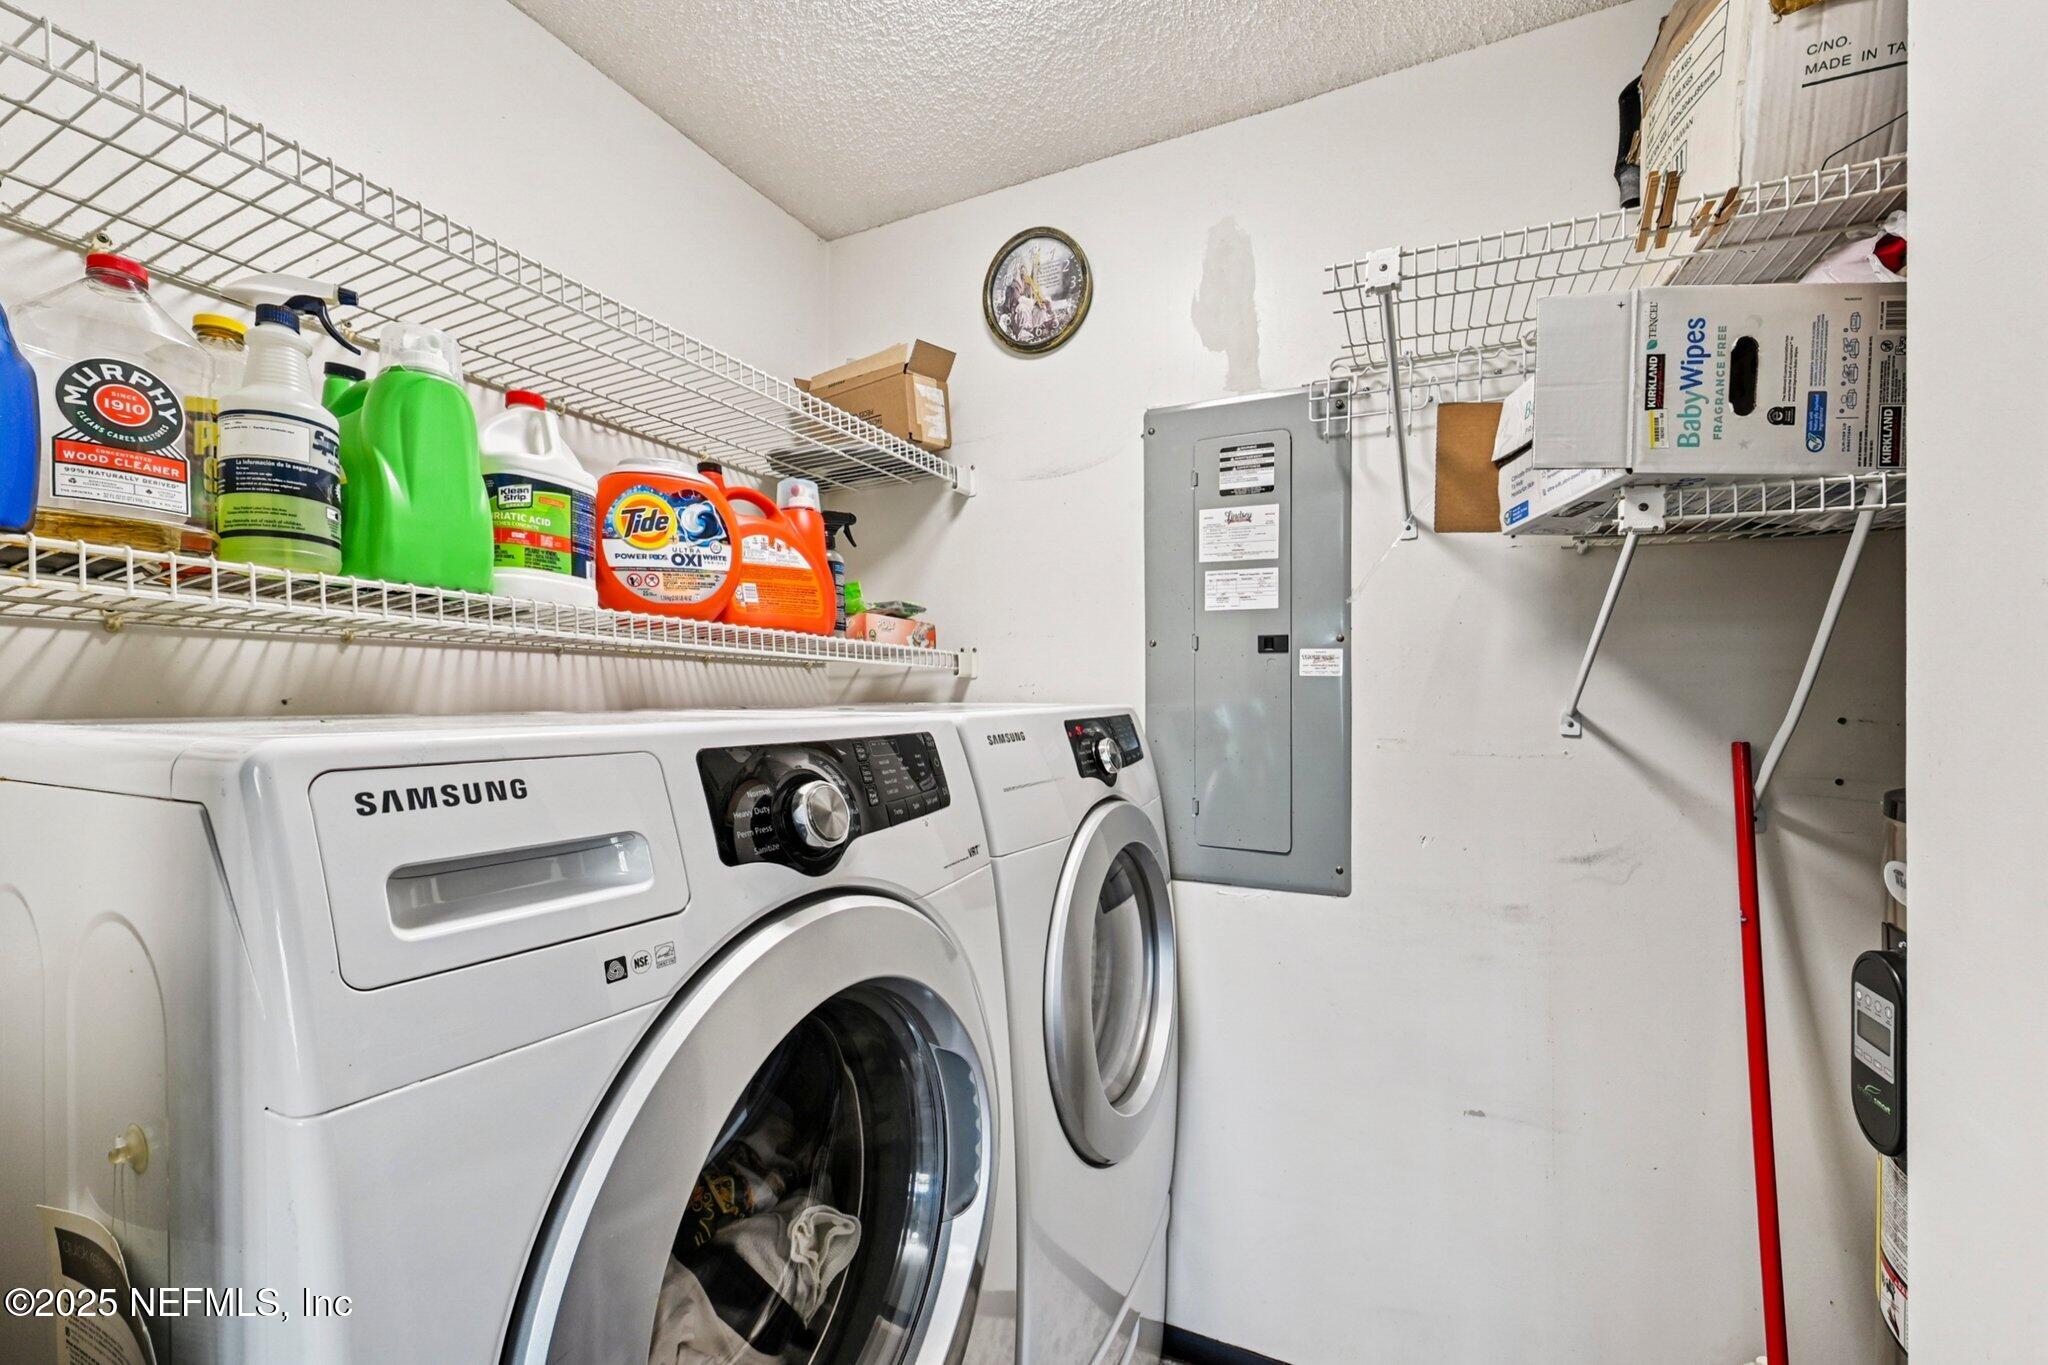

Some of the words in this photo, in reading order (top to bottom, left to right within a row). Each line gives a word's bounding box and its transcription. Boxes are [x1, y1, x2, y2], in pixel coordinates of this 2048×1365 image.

[1806, 36, 1852, 56] C/NO.
[1805, 54, 1852, 75] MADE
[1861, 48, 1878, 62] IN
[1887, 41, 1907, 55] TA
[1717, 325, 1727, 357] FREE
[1647, 356, 1658, 408] KIRKLAND
[63, 363, 178, 426] MURPHY
[111, 390, 137, 401] SINCE
[1713, 361, 1726, 440] FRAGRANCE
[103, 397, 146, 416] 1910
[76, 410, 105, 433] CLEANS
[107, 430, 136, 443] CARES
[138, 424, 170, 443] RESTORES
[1881, 408, 1894, 464] KIRKLAND
[62, 449, 109, 464] WOOD
[114, 456, 180, 478] CLEANER
[95, 448, 152, 463] CONCENTRATED
[64, 465, 85, 474] 99%
[87, 468, 139, 482] NATURALLY
[292, 465, 319, 475] seguridad
[500, 486, 530, 496] Klean
[503, 493, 527, 502] Strip
[493, 511, 528, 522] RIATIC
[529, 516, 551, 527] ACID
[621, 507, 670, 538] Tide
[614, 552, 648, 560] POWER
[671, 553, 702, 567] OXI
[986, 731, 1026, 746] SAMSUNG
[354, 778, 529, 817] SAMSUNG
[746, 787, 771, 799] Normal
[732, 810, 753, 819] Heavy
[753, 806, 770, 815] Duty
[736, 830, 755, 839] Perm
[754, 824, 773, 835] Press
[753, 843, 780, 855] Sanitize
